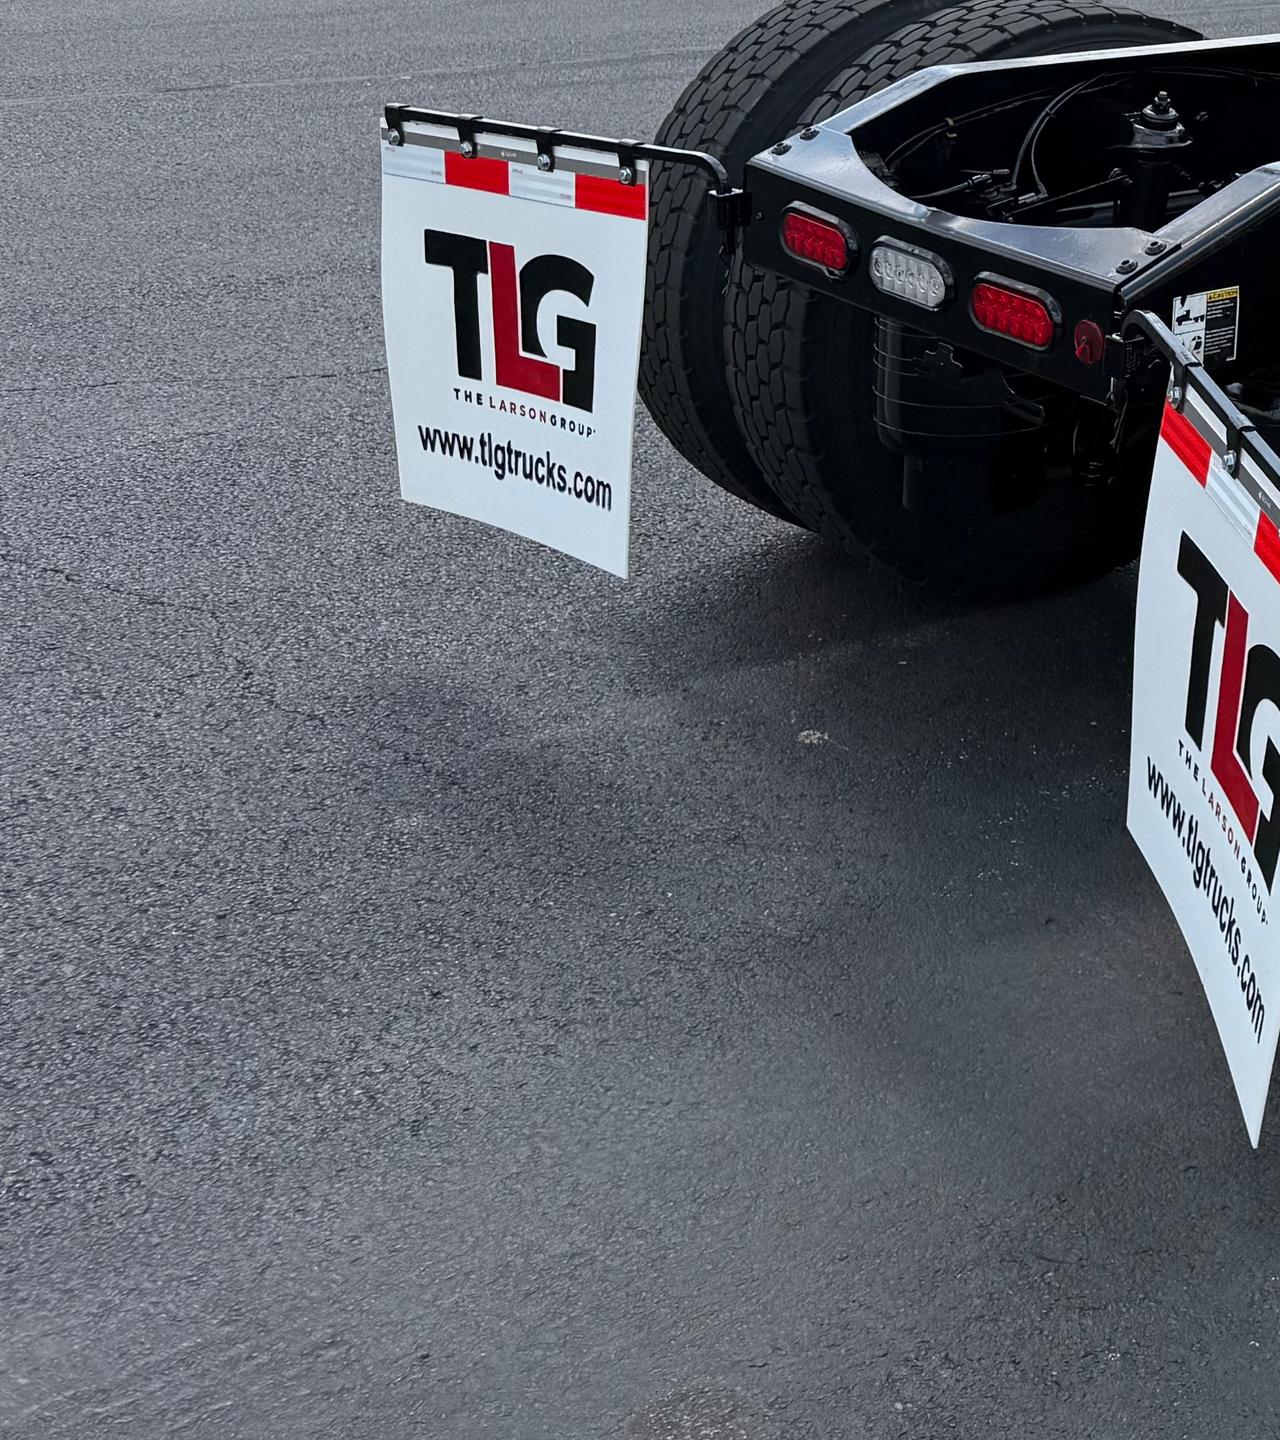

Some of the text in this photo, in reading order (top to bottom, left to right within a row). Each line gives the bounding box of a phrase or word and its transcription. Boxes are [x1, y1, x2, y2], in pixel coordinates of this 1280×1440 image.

[424, 228, 597, 413] TLG
[453, 387, 596, 438] THE LARSON GROUP
[417, 424, 613, 512] www.tlgtrucks.com
[1178, 739, 1200, 782] THE
[1147, 756, 1266, 1045] www.tlgtrucks.com
